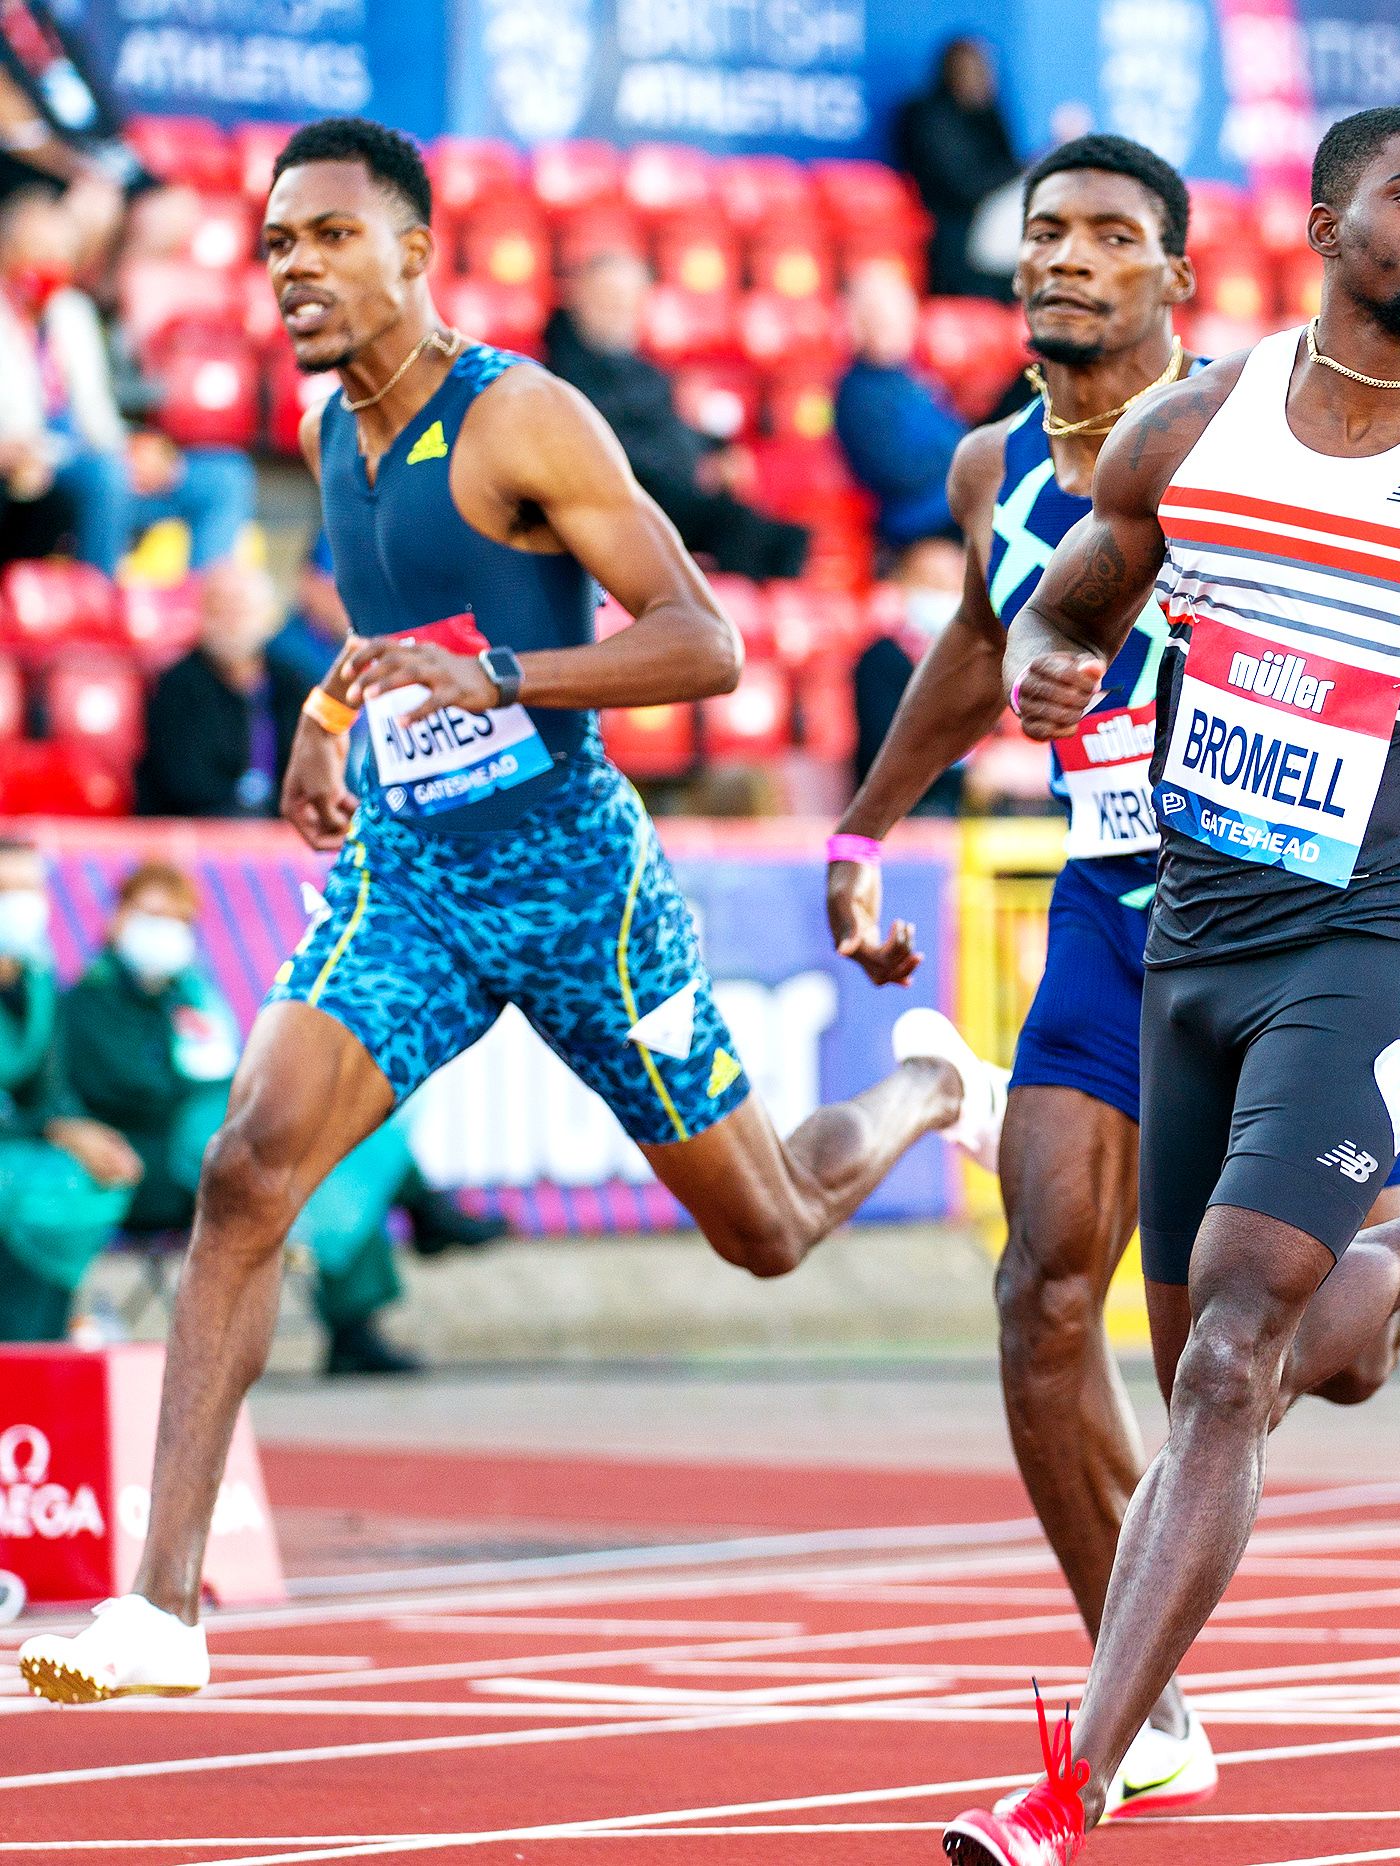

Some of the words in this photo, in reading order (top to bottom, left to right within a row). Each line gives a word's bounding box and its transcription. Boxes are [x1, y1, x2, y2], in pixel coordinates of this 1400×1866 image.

[1228, 650, 1336, 714] müller
[413, 753, 519, 805] GATESHEAD
[1183, 708, 1345, 818] BROMELL
[1201, 809, 1320, 863] GATESHEAD
[0, 1483, 105, 1539] EGA
